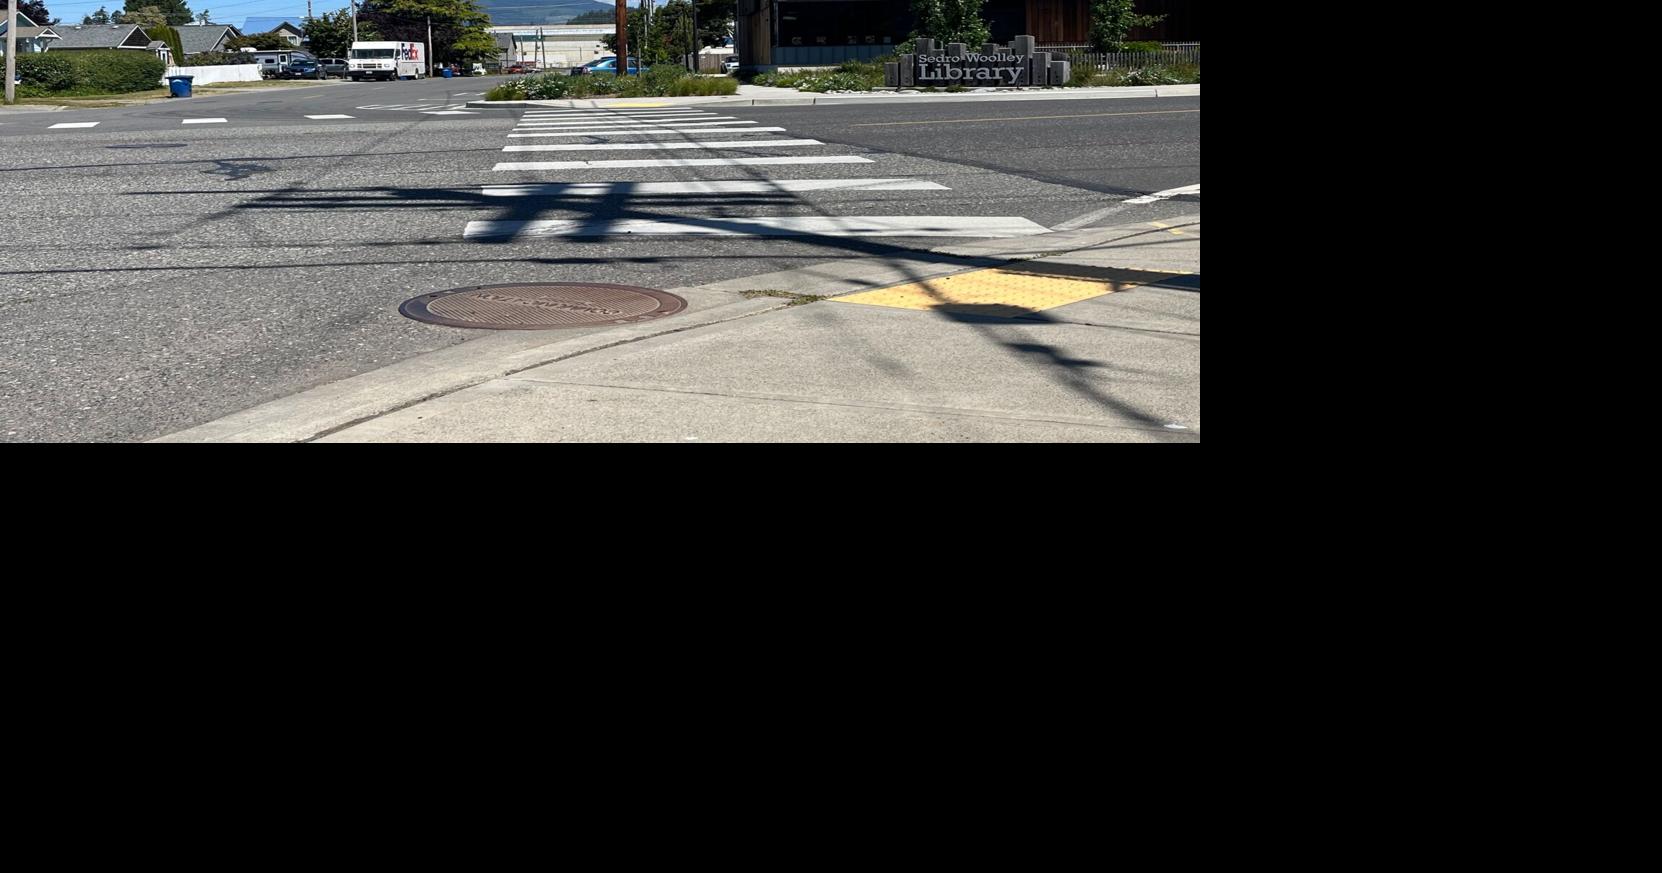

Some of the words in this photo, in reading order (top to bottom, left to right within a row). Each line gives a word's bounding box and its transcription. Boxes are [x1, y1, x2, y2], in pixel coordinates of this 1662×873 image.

[919, 54, 960, 63] Sedro
[965, 53, 1024, 63] Woolley
[919, 63, 1024, 84] Library
